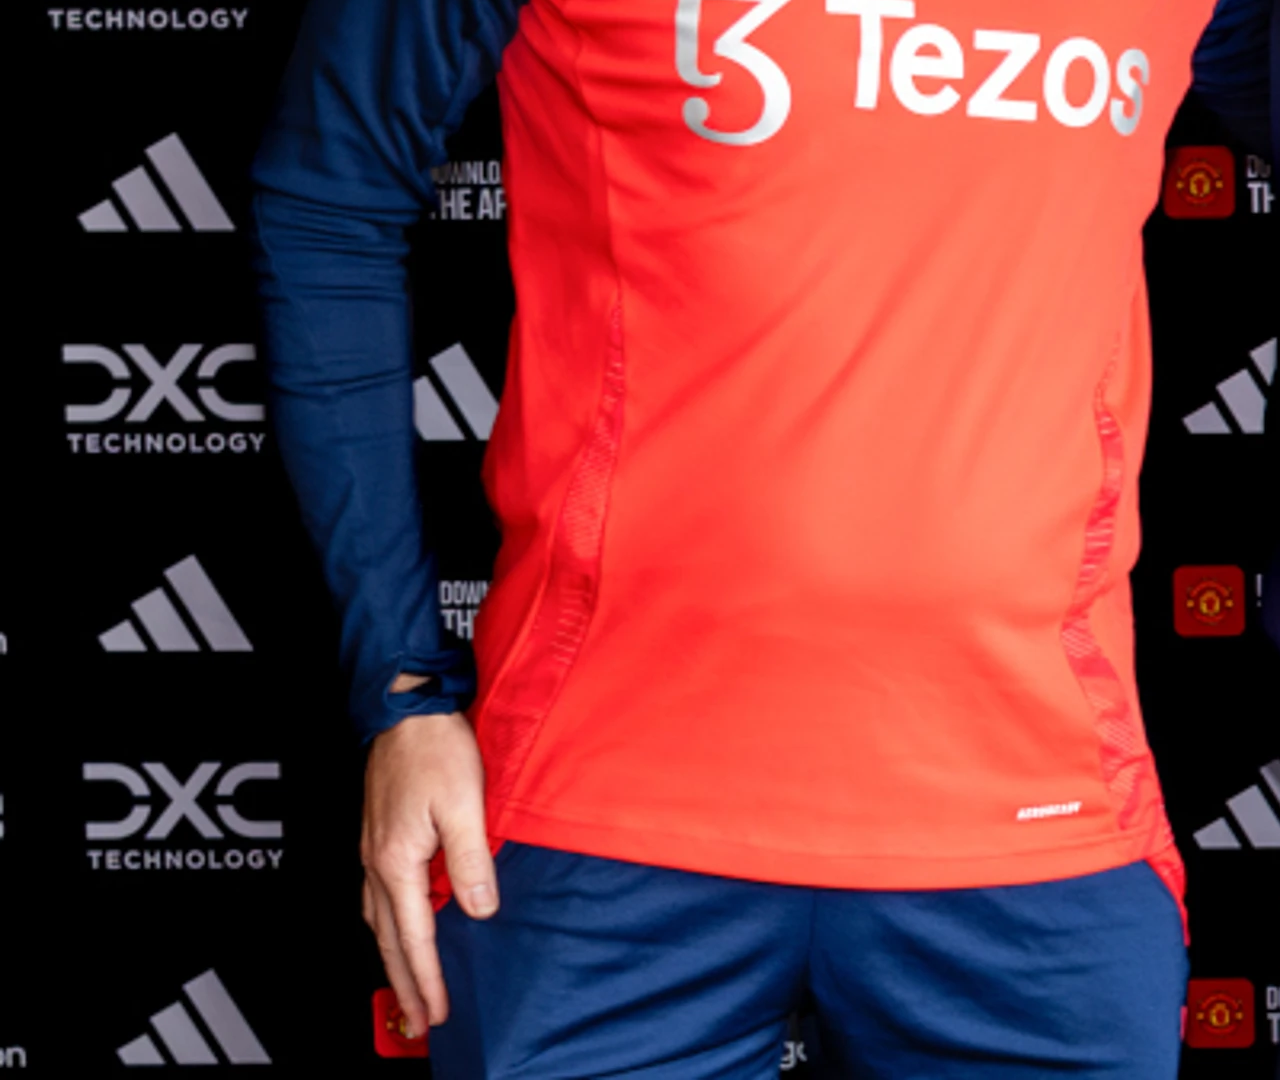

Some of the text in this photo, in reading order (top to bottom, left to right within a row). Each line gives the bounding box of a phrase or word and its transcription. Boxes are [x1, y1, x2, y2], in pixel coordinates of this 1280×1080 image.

[48, 9, 247, 29] TECHNOLOGY
[63, 344, 263, 422] DXC
[67, 433, 263, 453] TECHNOLOGY
[83, 763, 282, 840] DXC
[87, 849, 282, 869] TECHNOLOGY
